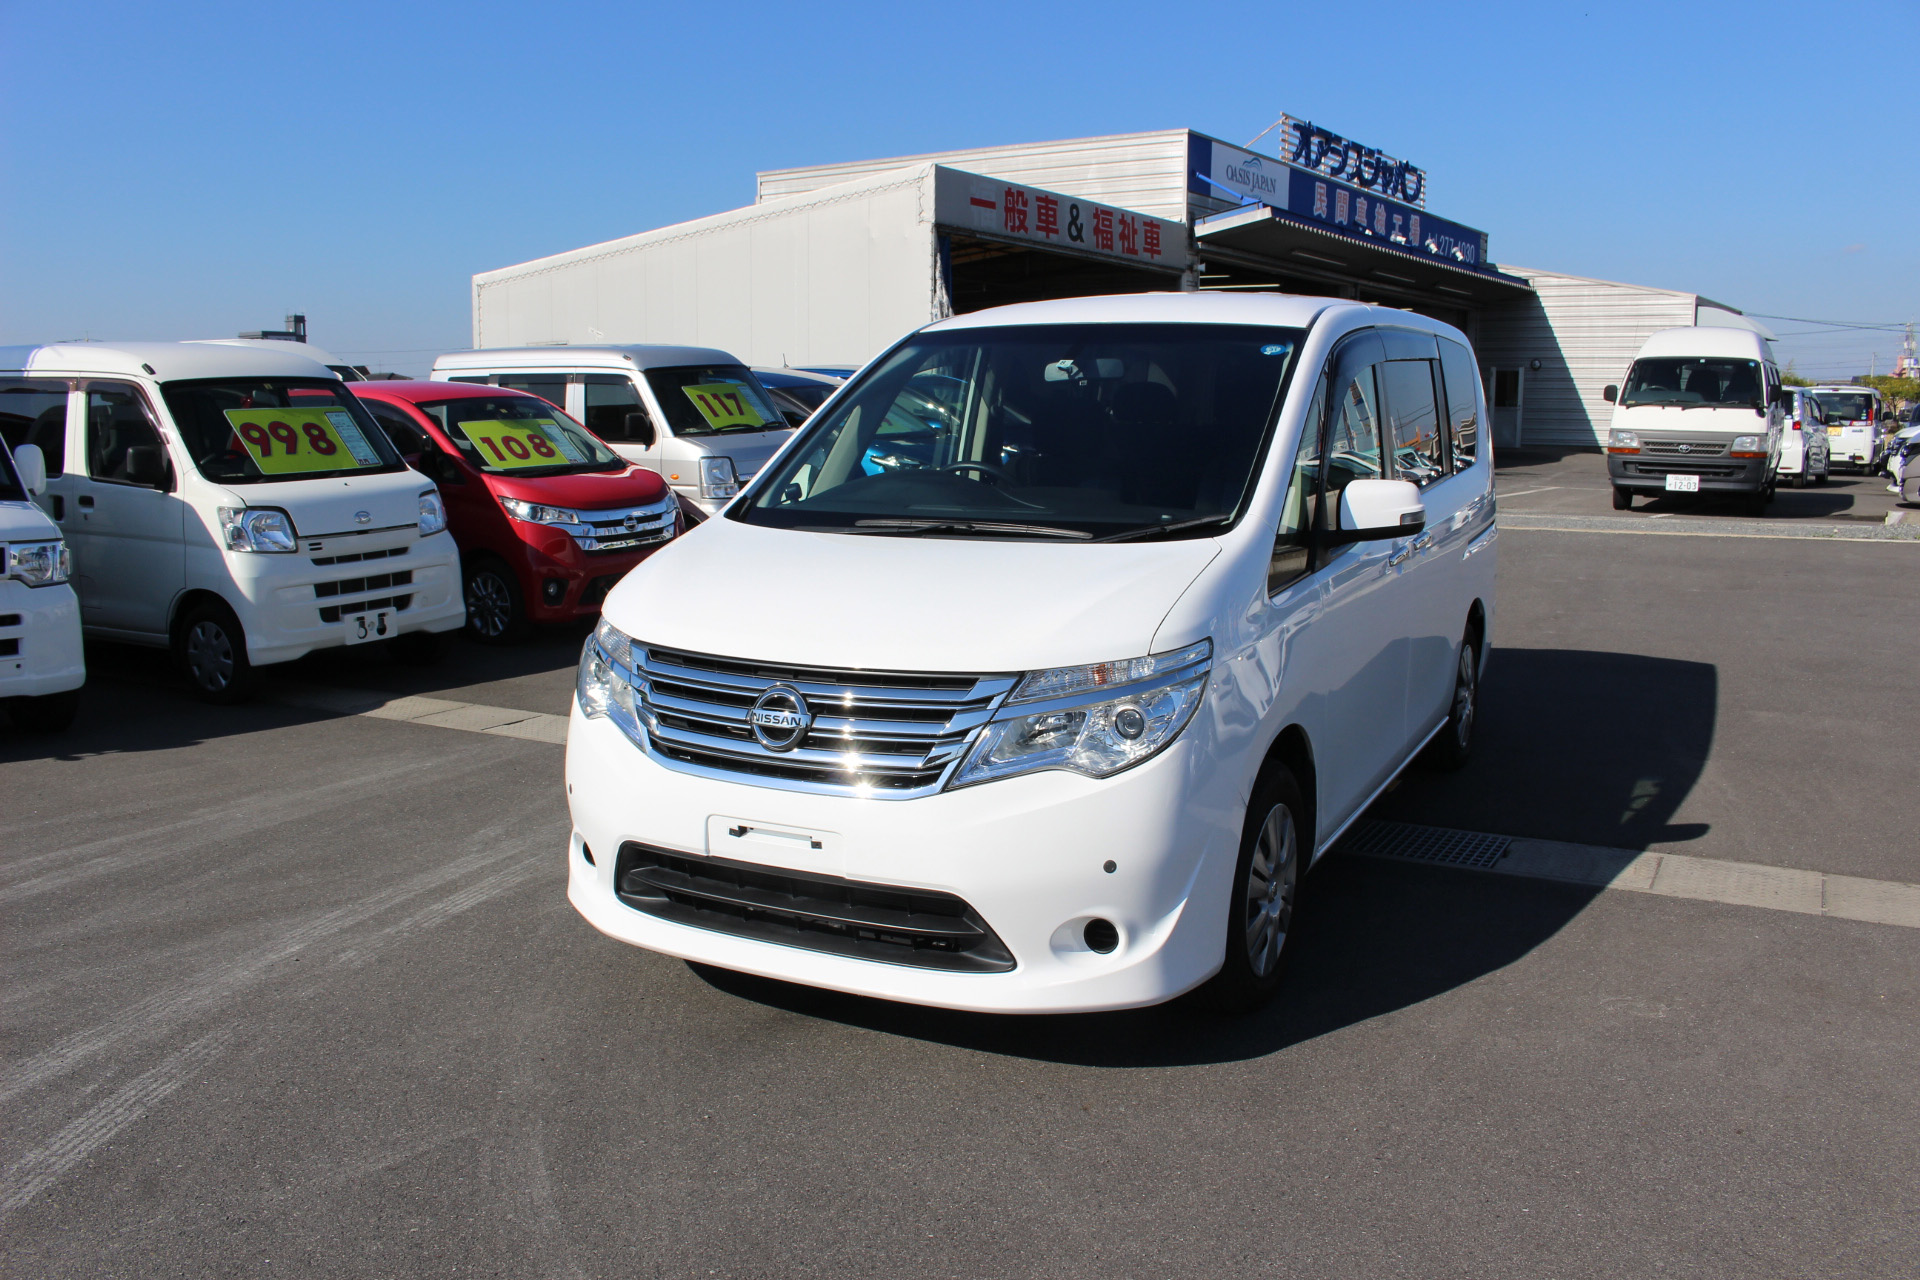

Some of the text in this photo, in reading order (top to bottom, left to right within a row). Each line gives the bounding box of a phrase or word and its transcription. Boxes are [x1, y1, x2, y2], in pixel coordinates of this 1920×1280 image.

[1226, 164, 1277, 194] OASIS JAPAN
[1313, 181, 1421, 247] 民間車検工場
[696, 392, 745, 418] 117
[479, 433, 556, 462] 108
[752, 712, 802, 726] NISSAN
